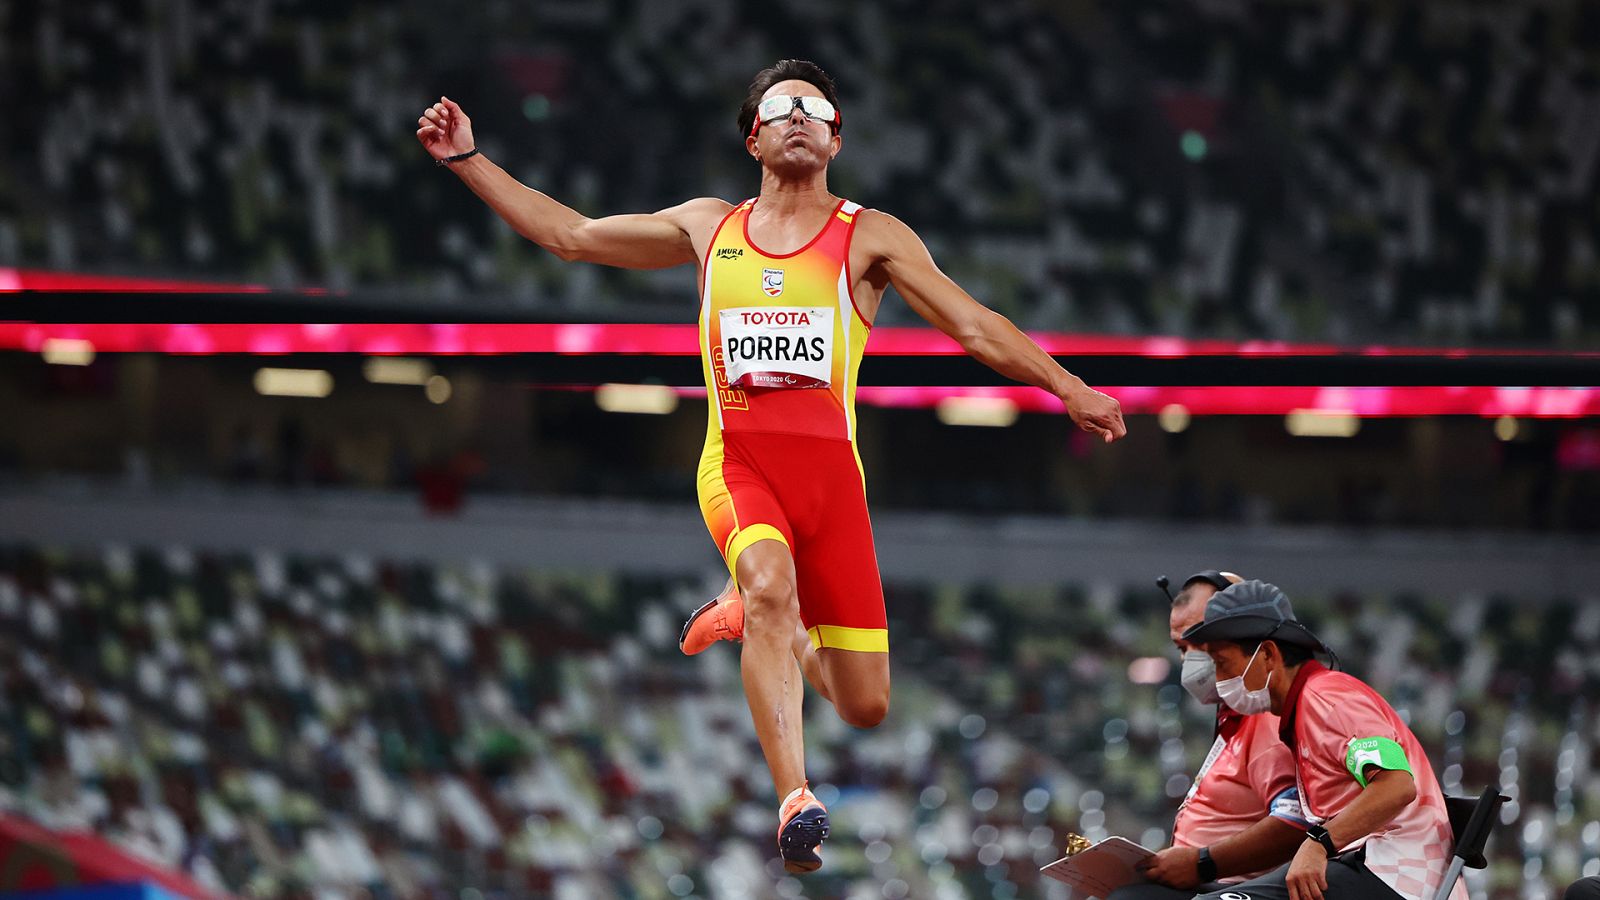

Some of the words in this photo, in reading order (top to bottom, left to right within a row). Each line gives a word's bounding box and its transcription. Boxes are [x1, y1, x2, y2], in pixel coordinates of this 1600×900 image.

[716, 248, 744, 257] AMURA
[741, 312, 810, 325] TOYOTA
[727, 336, 825, 362] PORRAS
